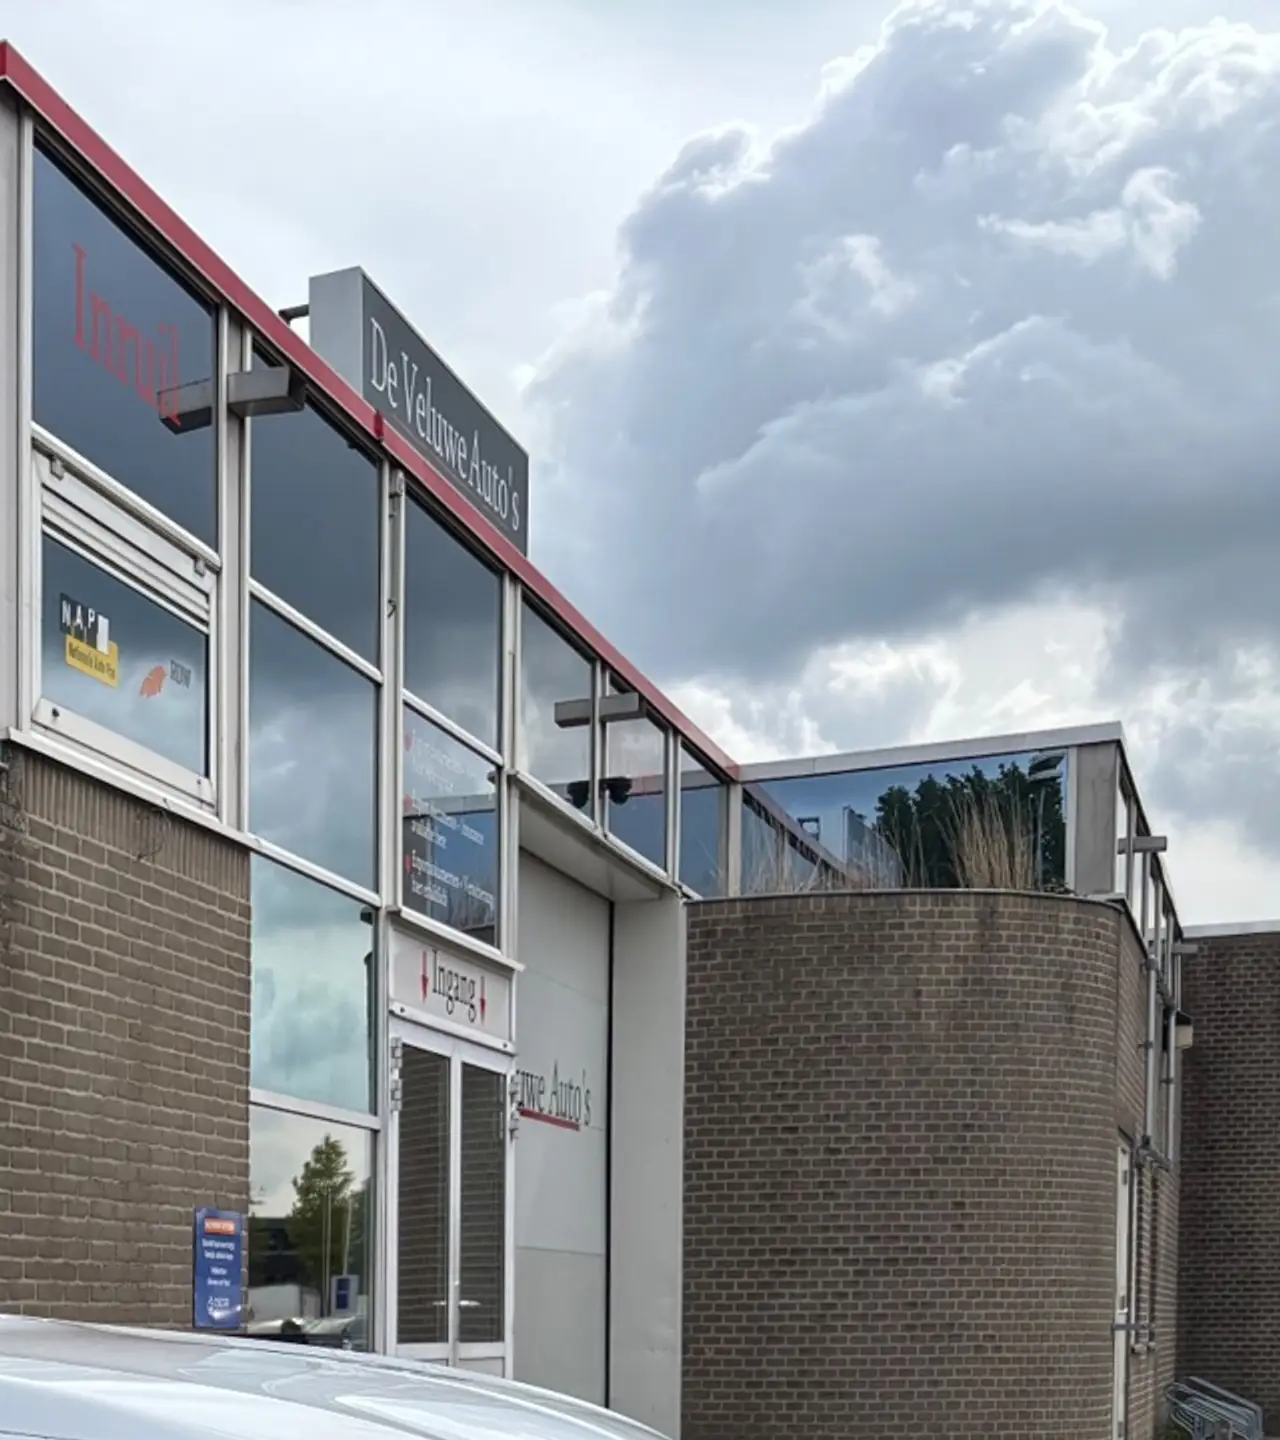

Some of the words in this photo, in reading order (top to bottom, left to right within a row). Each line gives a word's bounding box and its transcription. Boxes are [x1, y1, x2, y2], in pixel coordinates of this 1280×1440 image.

[371, 317, 398, 409] De
[401, 351, 468, 479] Veluwe
[468, 429, 520, 531] Auto's
[432, 949, 476, 1023] Ingang
[516, 1070, 544, 1112] uwe
[548, 1060, 591, 1127] Auto's
